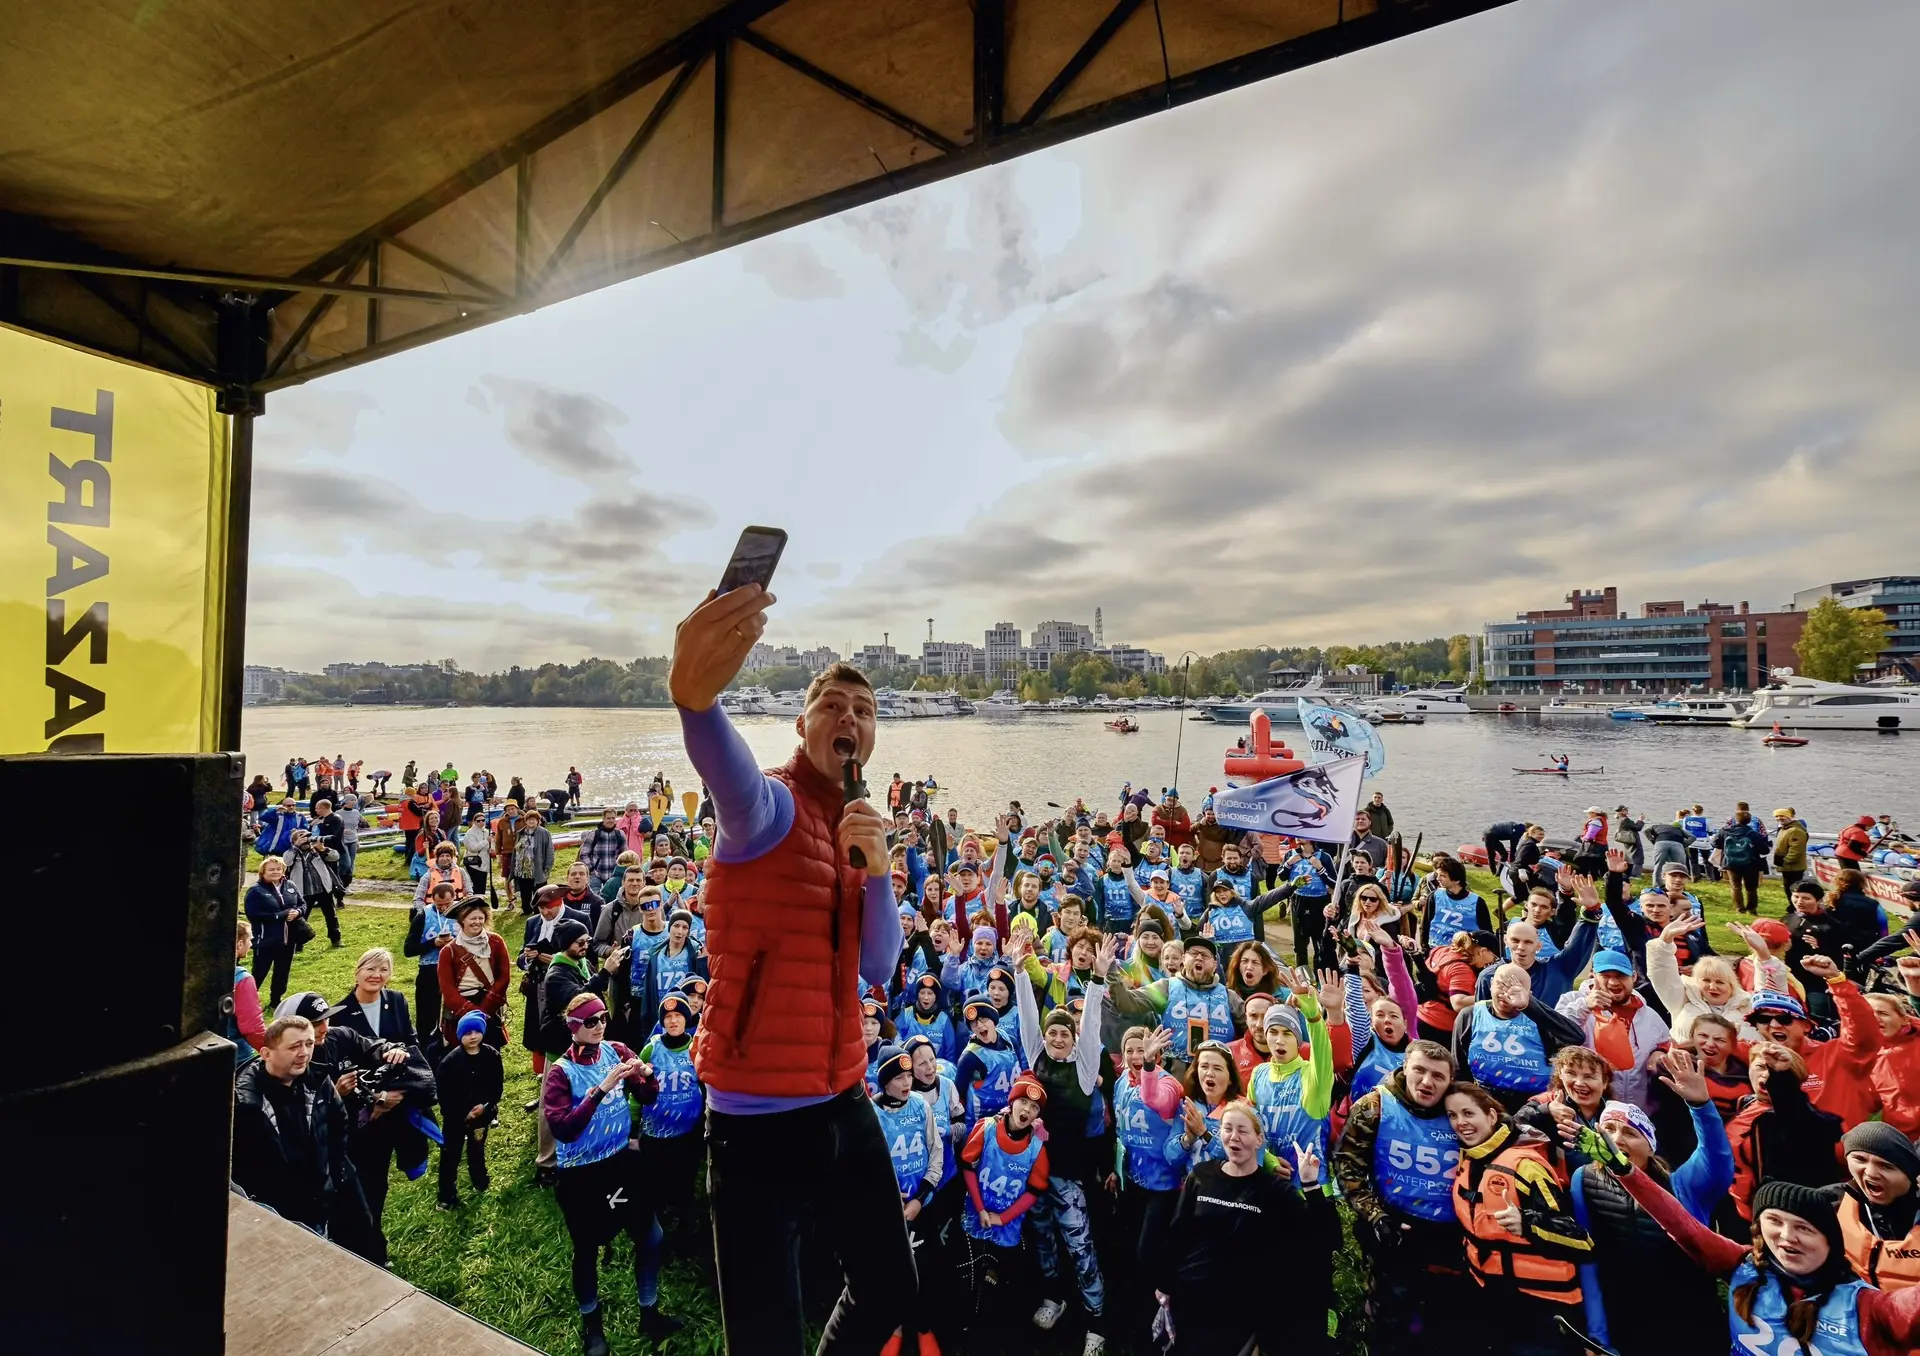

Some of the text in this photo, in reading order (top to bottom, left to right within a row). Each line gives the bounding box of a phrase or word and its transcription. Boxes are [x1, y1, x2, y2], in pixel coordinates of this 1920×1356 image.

[1107, 889, 1127, 900] 111
[1178, 884, 1196, 897] 29
[1213, 916, 1244, 931] 104
[1440, 908, 1464, 928] 72
[1171, 1000, 1229, 1025] 644
[1482, 1031, 1526, 1056] 66
[1472, 1052, 1539, 1068] WATERPOINT
[591, 1098, 627, 1121] ATERPOIN
[1430, 1130, 1459, 1142] CANO
[1388, 1138, 1460, 1180] 552
[979, 1166, 1023, 1200] 443
[1387, 1169, 1455, 1192] WATERPOI
[1815, 1320, 1848, 1338] NOE
